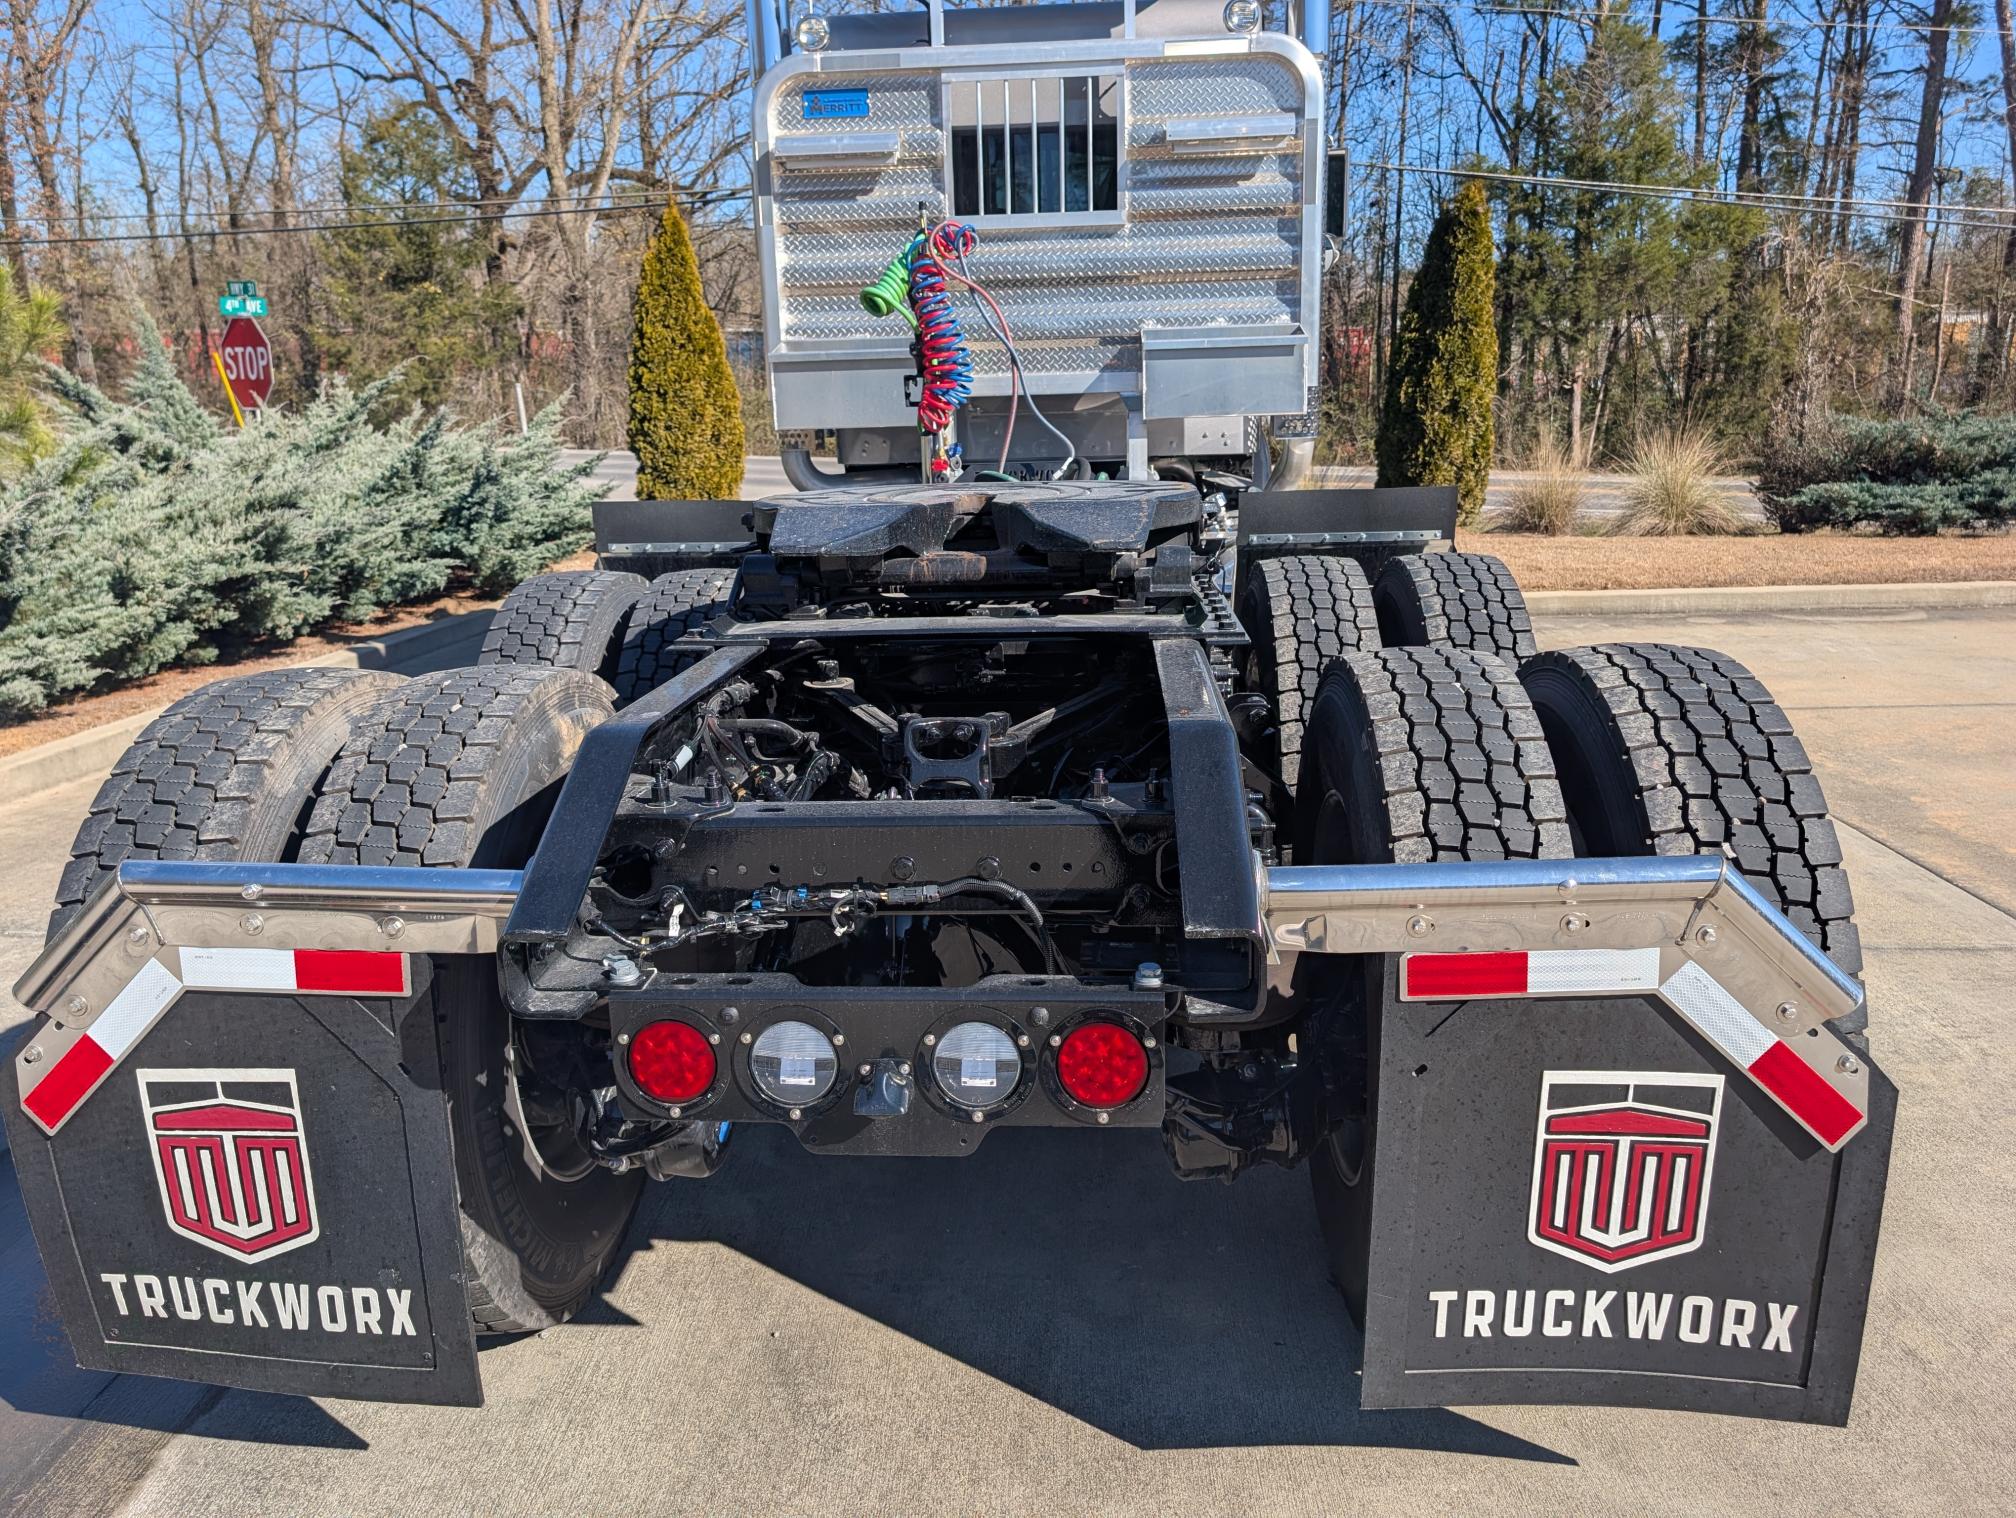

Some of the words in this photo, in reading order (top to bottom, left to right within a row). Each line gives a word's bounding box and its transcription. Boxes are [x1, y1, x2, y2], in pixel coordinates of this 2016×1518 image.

[245, 300, 262, 314] AVE
[224, 346, 268, 381] STOP
[100, 1273, 417, 1336] TRUCKWORX
[1428, 1288, 1799, 1353] TRUCKWORX
